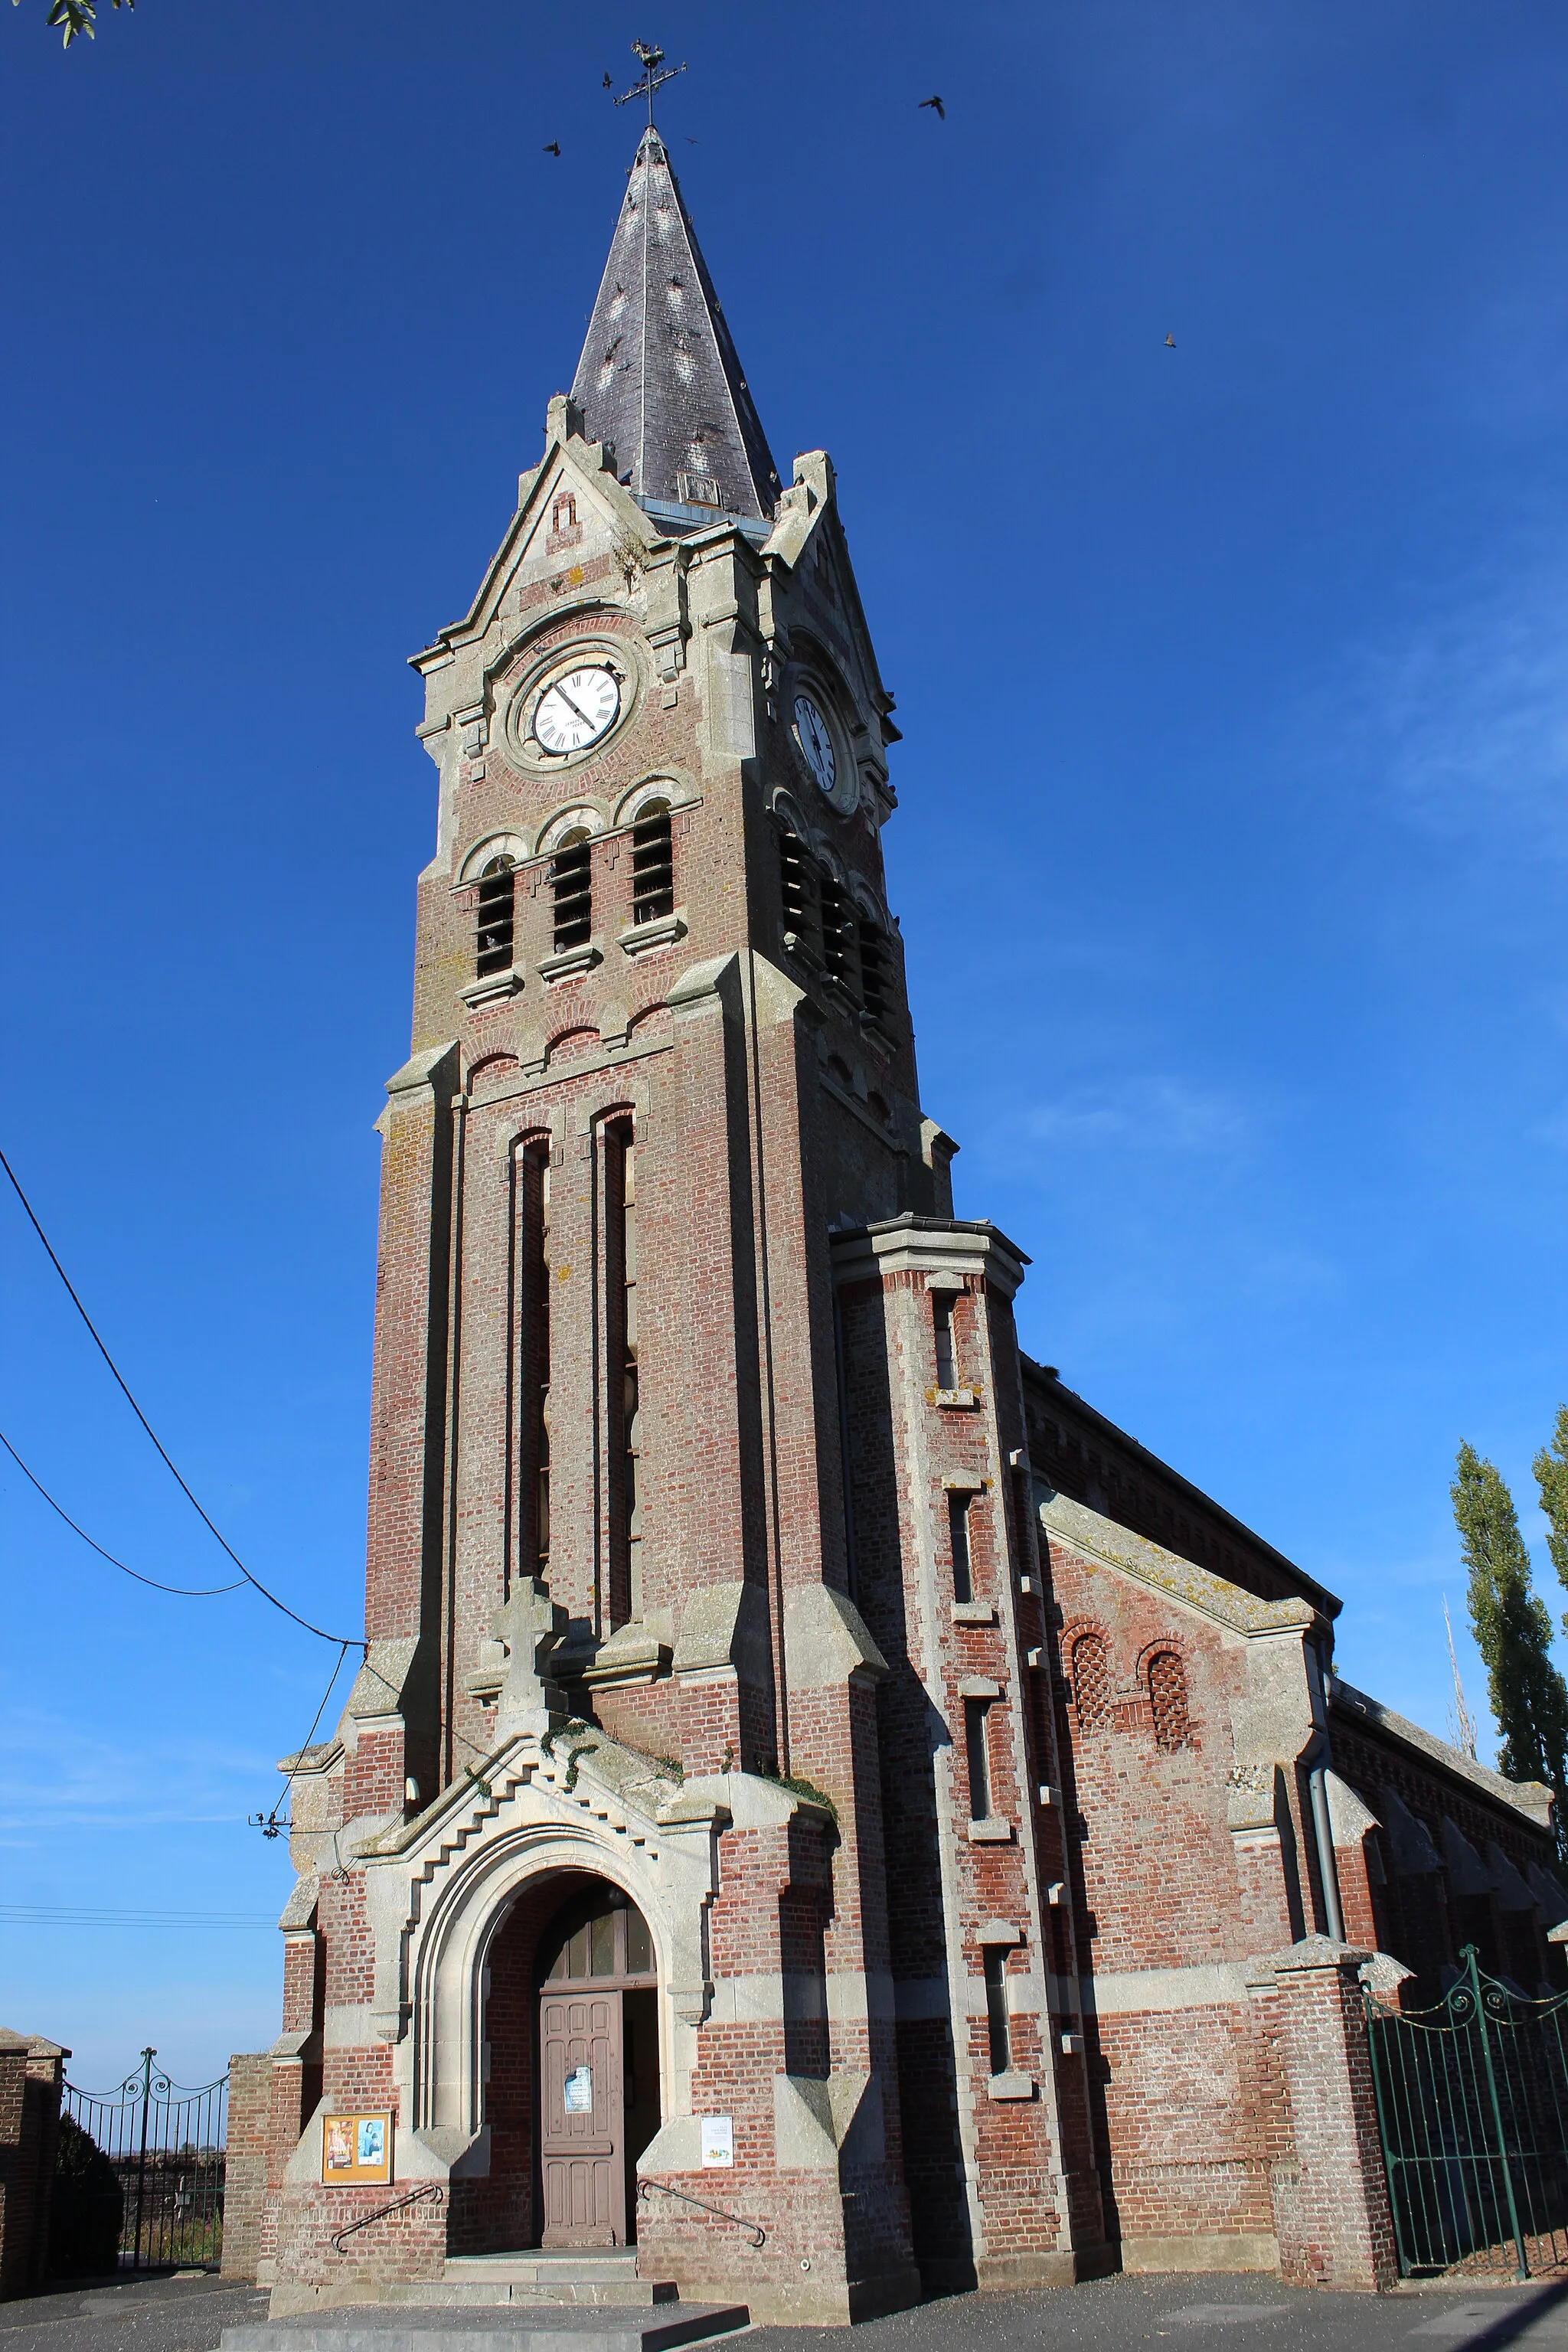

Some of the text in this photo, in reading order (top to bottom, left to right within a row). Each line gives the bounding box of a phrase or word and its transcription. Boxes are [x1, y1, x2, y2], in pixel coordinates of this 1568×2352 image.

[572, 675, 581, 688] XII
[596, 680, 609, 692] II
[600, 694, 614, 704] III
